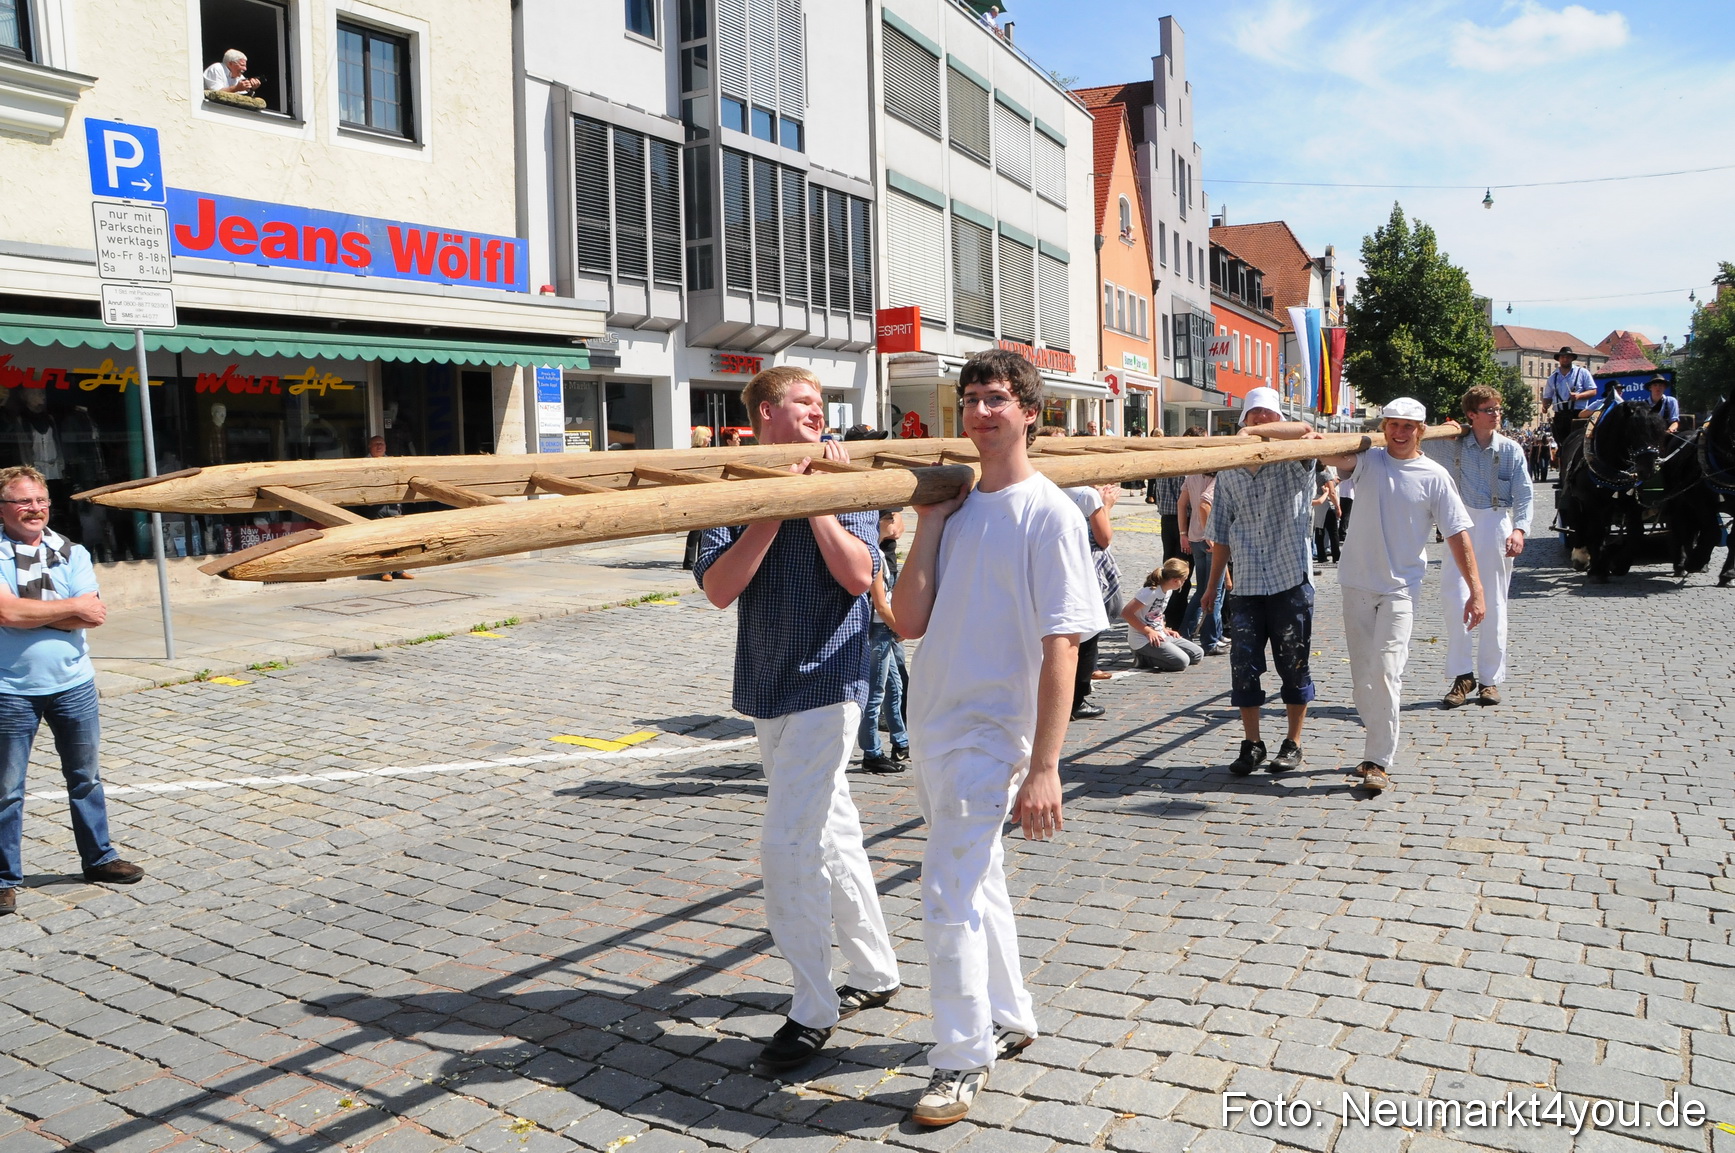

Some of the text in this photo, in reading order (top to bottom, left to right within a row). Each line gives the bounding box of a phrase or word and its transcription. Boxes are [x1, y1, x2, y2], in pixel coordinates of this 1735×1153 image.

[103, 129, 144, 188] P
[109, 211, 152, 222] nur mit
[100, 220, 163, 236] Parkschein
[107, 235, 159, 250] werktags
[174, 198, 515, 285] Jeans Wölfl
[101, 249, 133, 260] Mo-Fr
[103, 263, 116, 272] Sa
[878, 323, 913, 336] ESPRIT
[1208, 341, 1229, 357] H&M
[721, 354, 764, 375] ESPRIT
[284, 366, 355, 396] Life
[240, 527, 259, 535] New
[240, 534, 260, 544] 2009
[242, 542, 257, 550] CO
